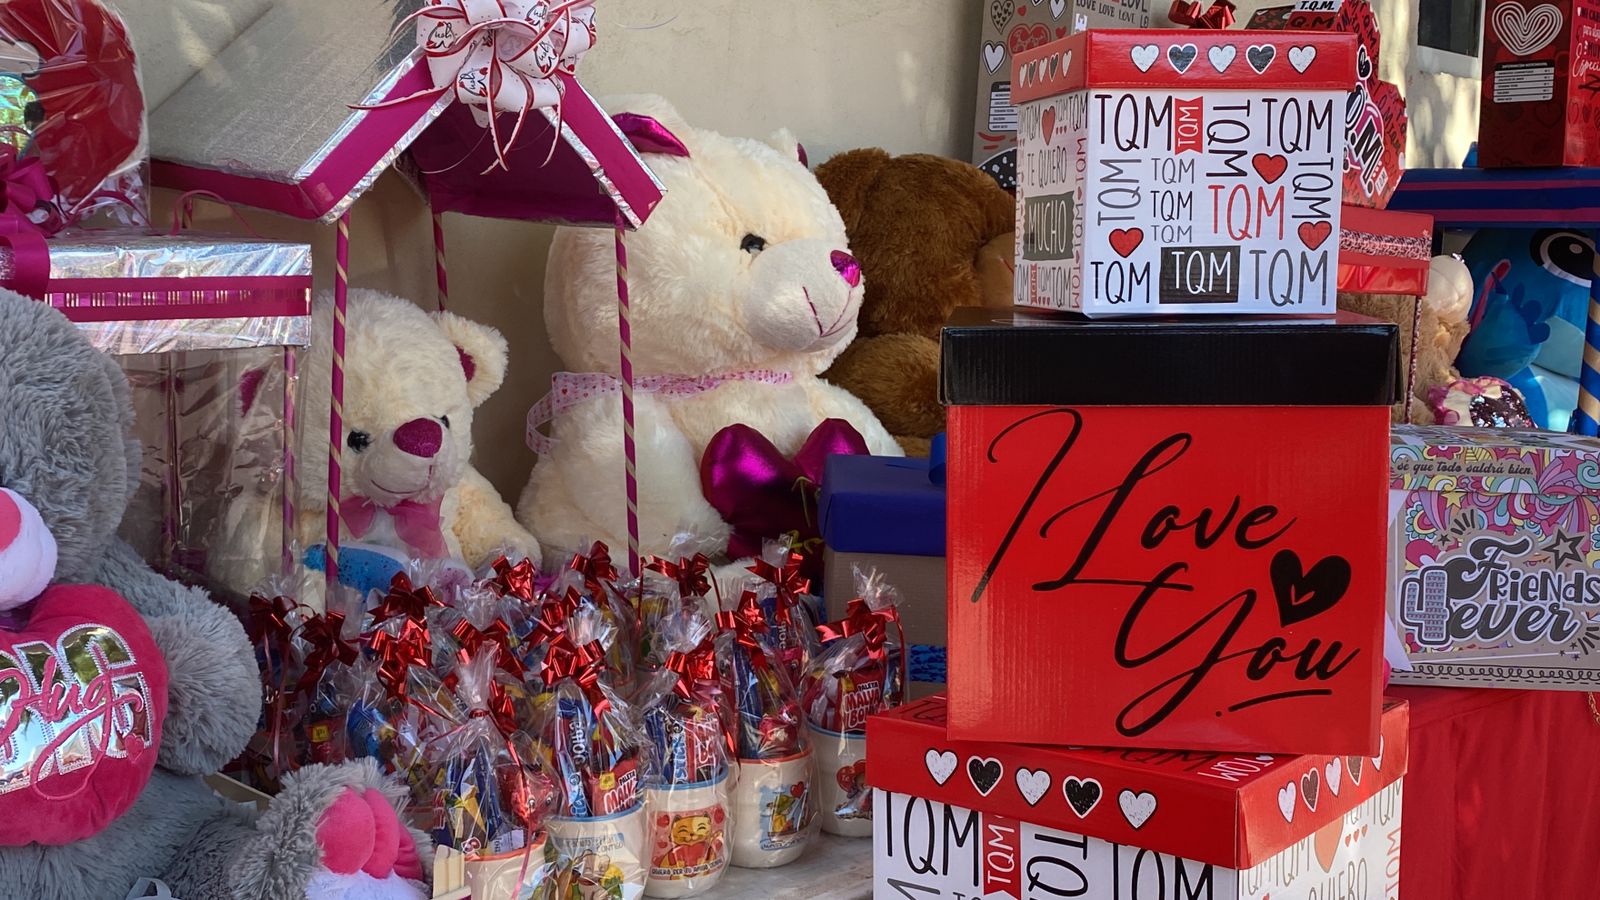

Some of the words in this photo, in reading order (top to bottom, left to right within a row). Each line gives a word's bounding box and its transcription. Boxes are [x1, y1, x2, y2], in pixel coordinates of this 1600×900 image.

[1069, 91, 1088, 132] TQM
[1094, 93, 1173, 152] TQM
[1177, 105, 1200, 147] TQM
[1261, 97, 1334, 154] TQM
[1206, 99, 1251, 178] TQM
[1038, 146, 1067, 189] QUIERO
[1097, 158, 1143, 226] TQM
[1150, 157, 1196, 184] TQM
[1292, 157, 1335, 219] TQM
[1028, 200, 1067, 254] MUCHO
[1150, 190, 1194, 222] TQM
[1208, 183, 1286, 242] TQM
[1150, 224, 1193, 244] TQM
[1052, 265, 1071, 309] TQM
[1090, 260, 1151, 305] TQM
[1171, 251, 1232, 295] TQM
[1249, 248, 1329, 308] TQM
[1397, 458, 1409, 471] sé
[1413, 463, 1434, 474] que
[1437, 460, 1462, 474] todo
[1465, 461, 1505, 475] saldrá
[1030, 432, 1299, 593] Love
[1113, 561, 1362, 738] You
